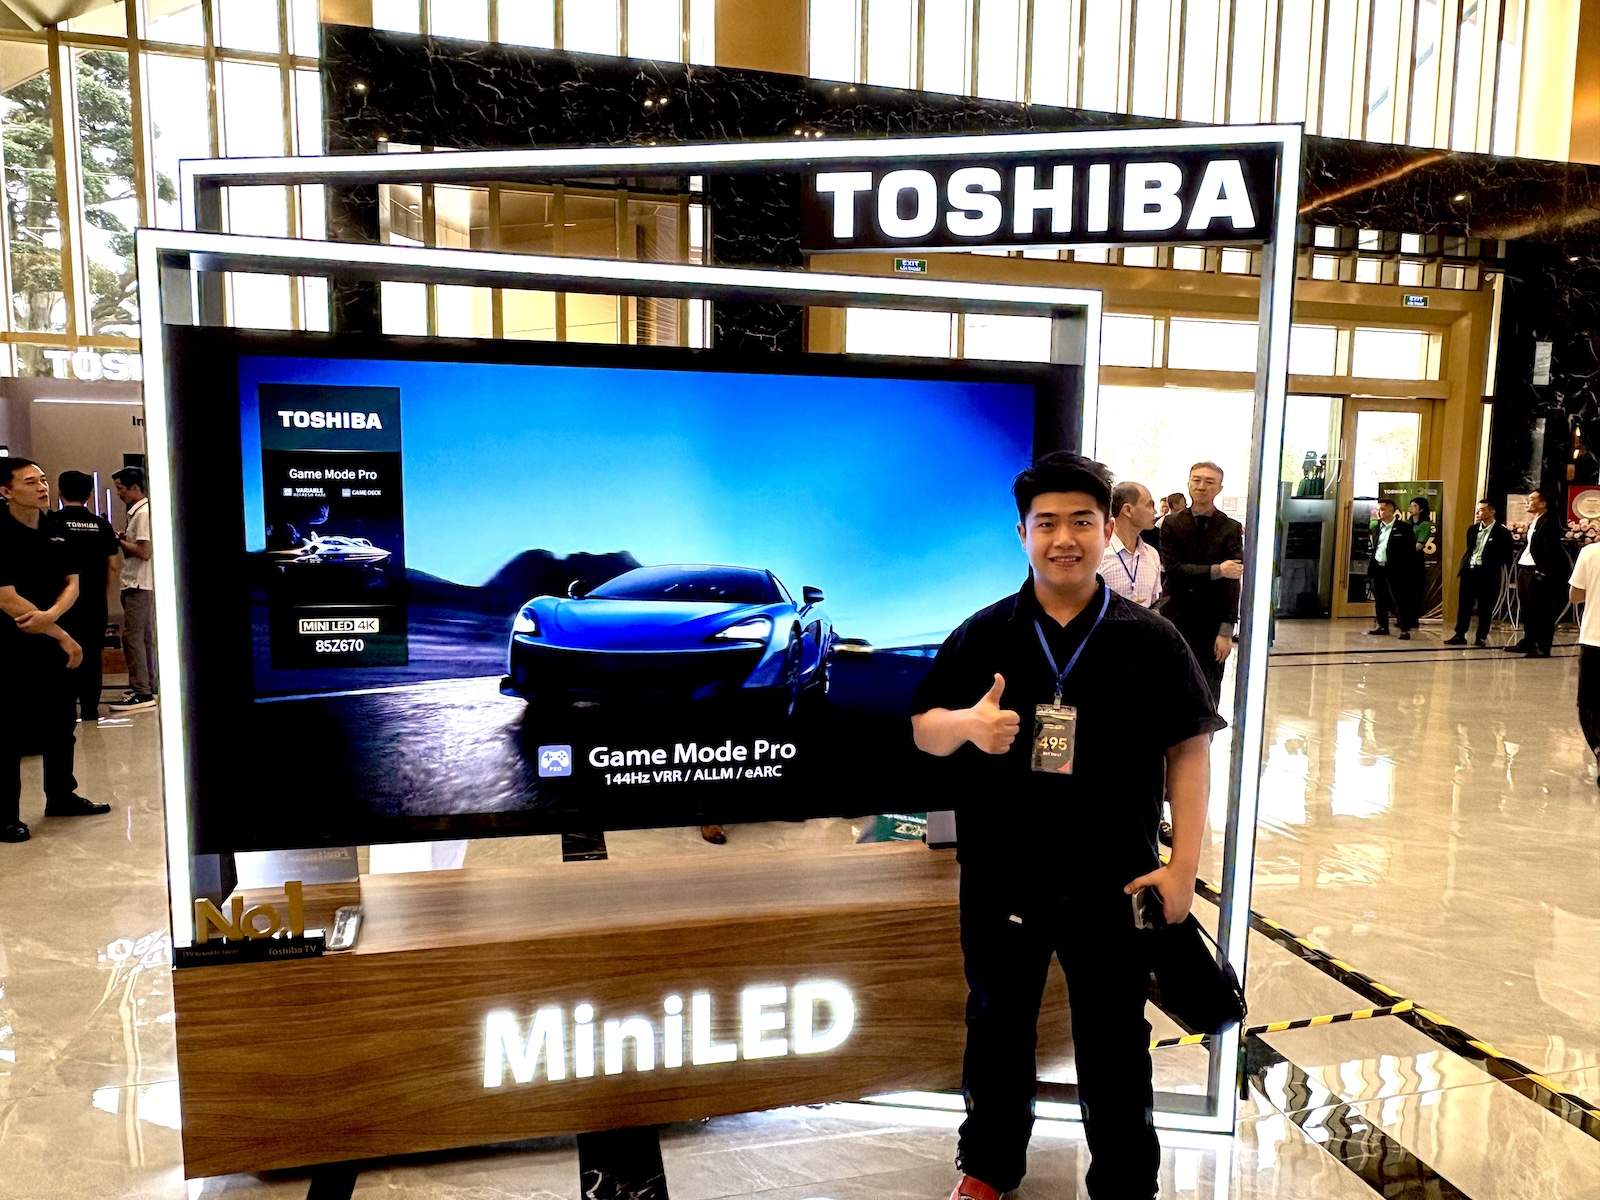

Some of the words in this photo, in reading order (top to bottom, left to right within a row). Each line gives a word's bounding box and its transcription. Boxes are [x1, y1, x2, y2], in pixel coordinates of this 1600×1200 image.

[815, 159, 1256, 239] TOSHIBA
[902, 259, 920, 267] EXIT
[278, 410, 383, 430] TOSHIBA
[289, 468, 323, 479] Game
[325, 469, 356, 480] Mode
[358, 469, 378, 480] Pro
[66, 521, 99, 529] TOSHIBA
[303, 620, 330, 631] MINI
[331, 620, 354, 631] LED
[357, 619, 376, 630] 4K
[315, 638, 365, 652] 85Z670
[1038, 736, 1068, 751] 495
[588, 746, 668, 768] Game
[673, 739, 748, 765] Mode
[753, 739, 797, 761] Pro
[604, 771, 651, 785] 144Hz
[652, 769, 682, 783] VRR
[693, 767, 734, 781] ALLM
[744, 765, 783, 779] eARC
[268, 947, 303, 956] Toshiba
[304, 944, 317, 953] TV
[482, 981, 856, 1089] MiniLED
